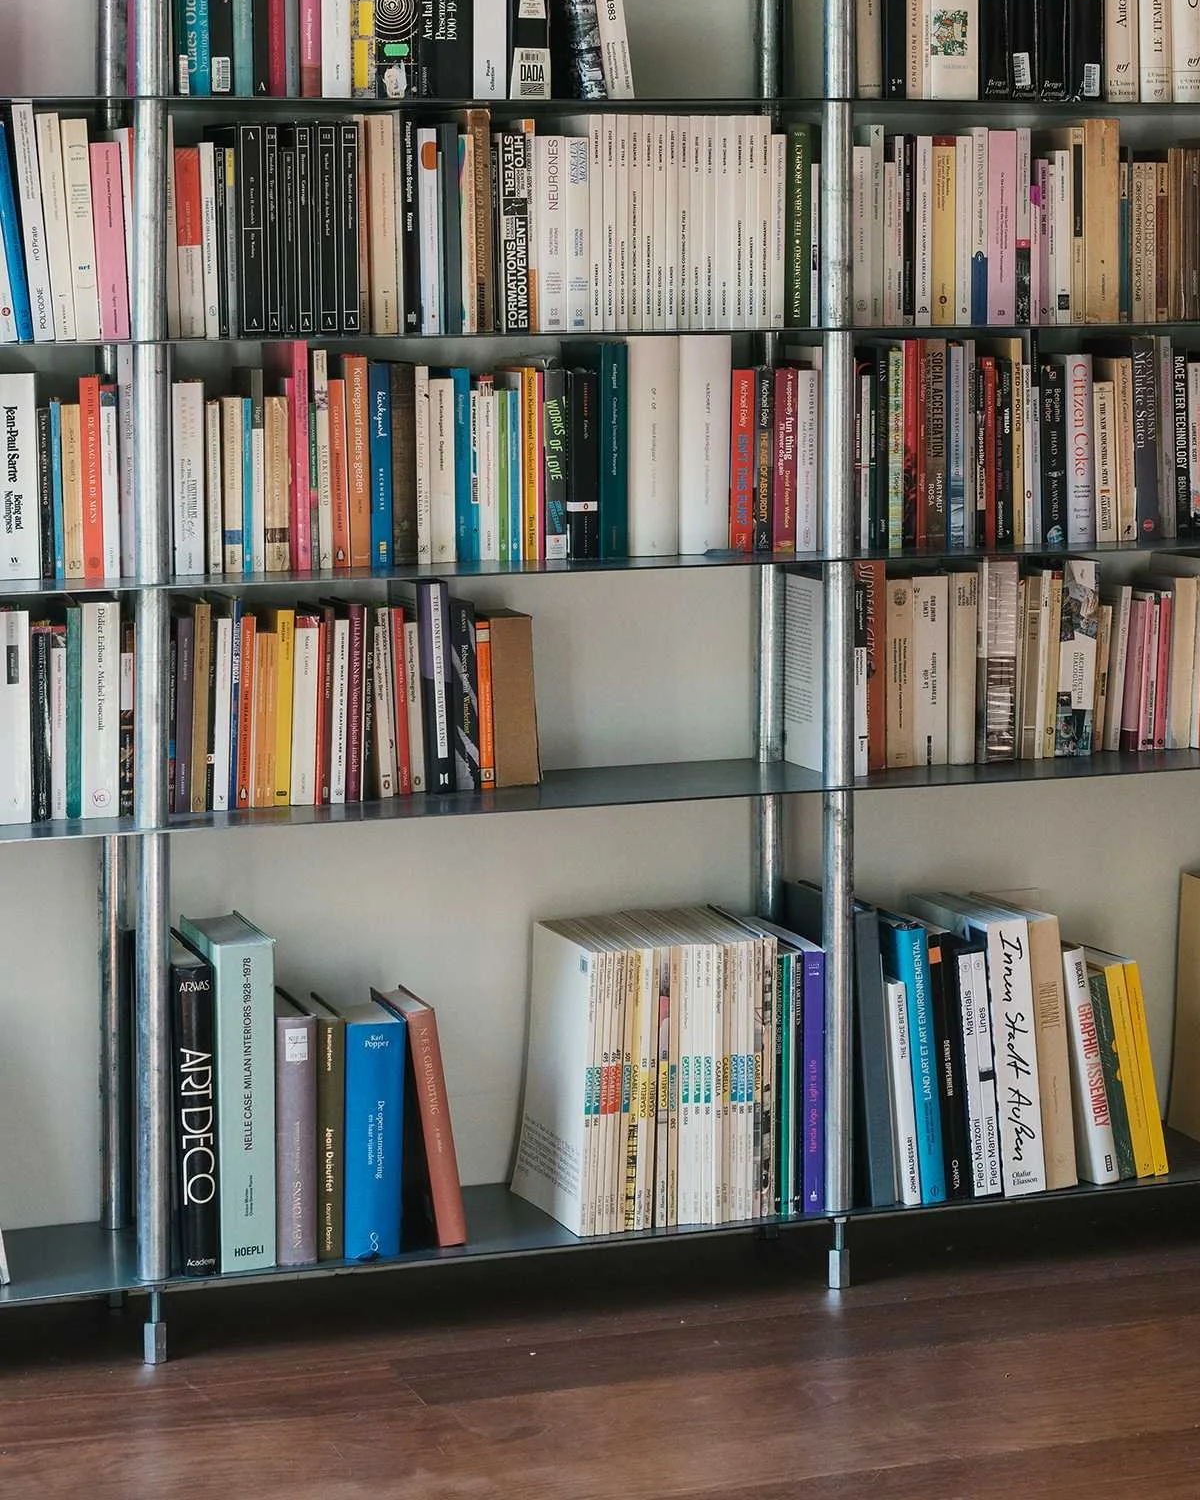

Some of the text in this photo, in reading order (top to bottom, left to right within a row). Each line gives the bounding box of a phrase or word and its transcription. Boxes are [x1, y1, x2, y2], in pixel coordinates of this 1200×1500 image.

[607, 0, 616, 20] 1983
[520, 64, 545, 82] DADA
[504, 136, 514, 195] STEYERL
[513, 136, 525, 167] HITO
[548, 140, 558, 210] NEURONES
[506, 241, 519, 329] FORMATIONS
[517, 219, 528, 328] EN MOUVEMENT
[353, 368, 361, 425] Kierkegaard
[932, 352, 943, 457] SOCIAL ACCELERATION
[1072, 364, 1089, 476] Citizen Coke
[1174, 356, 1187, 469] RACE AFTER TECHNOLOGY
[4, 406, 19, 483] Jean-Paul Sartre
[546, 400, 565, 480] WORKS OF LOVE
[14, 494, 22, 513] Being
[354, 463, 364, 493] gezien
[4, 491, 13, 533] Nothingness
[1075, 962, 1086, 988] BUCKLEY
[243, 1007, 251, 1056] INTERIORS
[965, 990, 975, 1035] Materials
[978, 1008, 986, 1033] Lines
[243, 1061, 251, 1089] MILAN
[999, 931, 1035, 1160] Innen Stadt Außen
[1078, 1004, 1109, 1127] GRAPHIC ASSEMBLY
[181, 1048, 214, 1205] ART DECO
[244, 1121, 252, 1150] NELLE
[973, 1119, 984, 1188] Piero Manzoni
[986, 1116, 998, 1186] Piero Manzoni
[325, 1128, 334, 1192] Jean Dubuffet
[235, 1248, 264, 1256] HOEPLI
